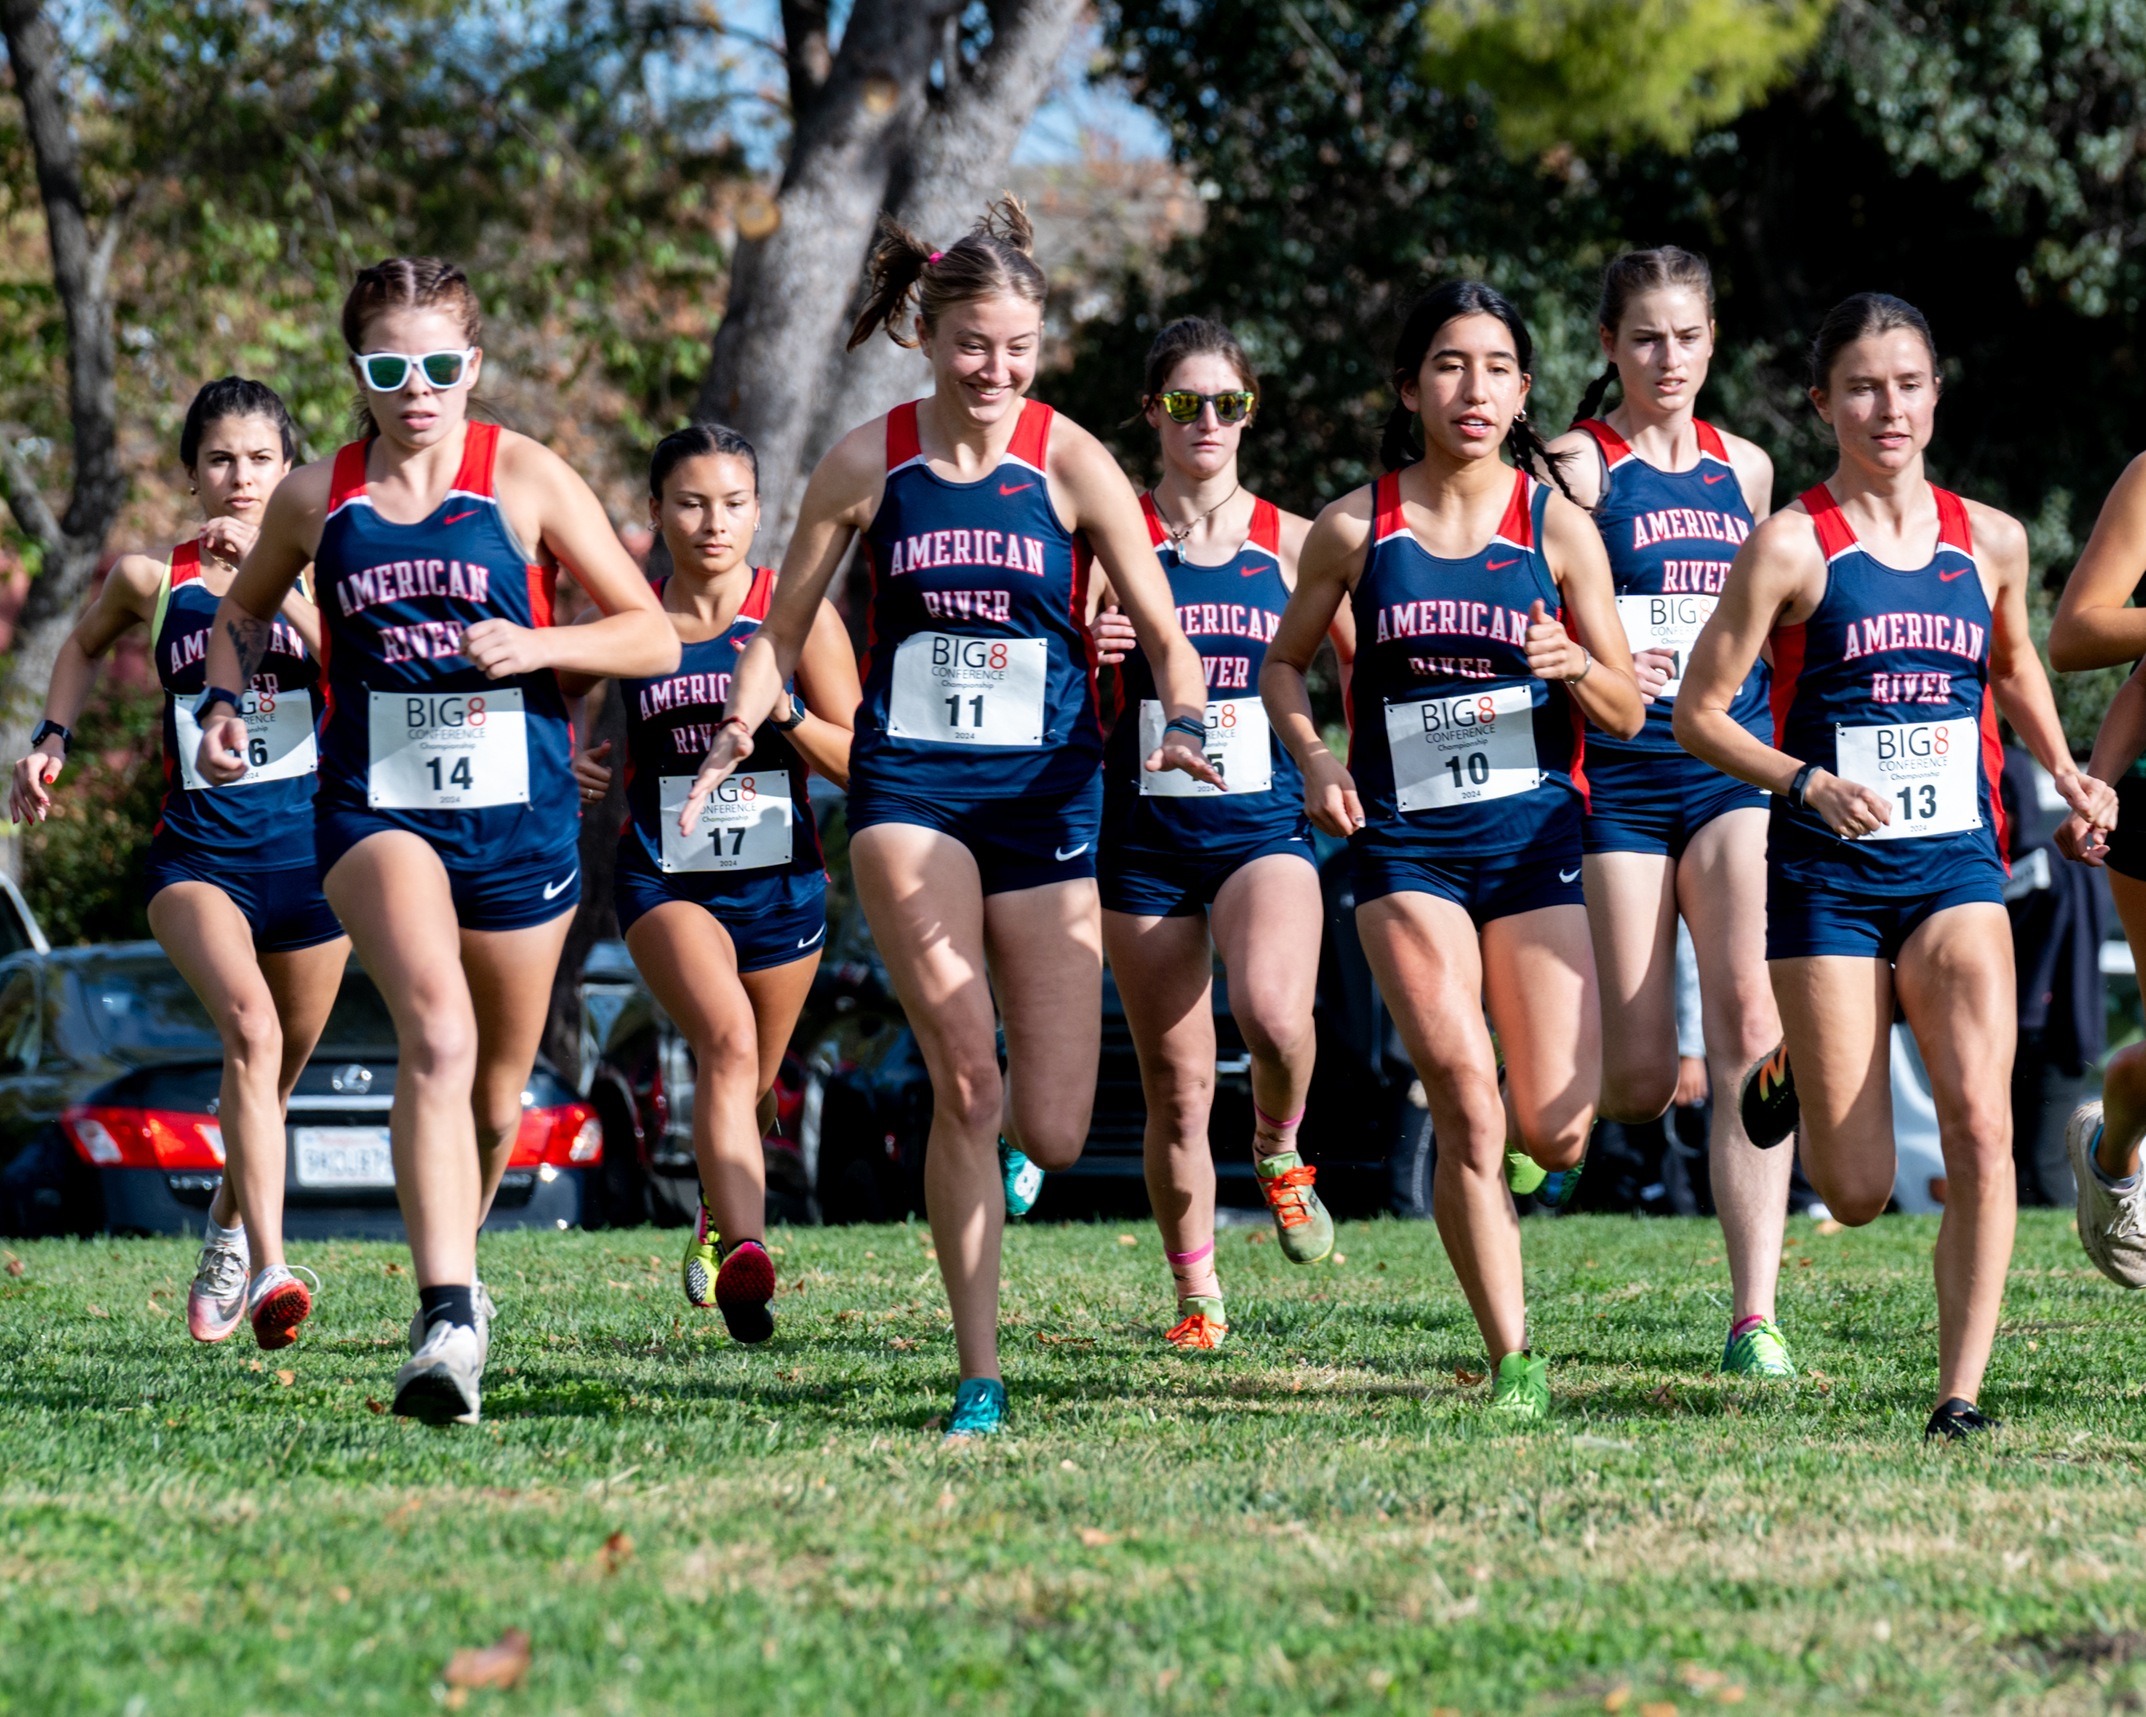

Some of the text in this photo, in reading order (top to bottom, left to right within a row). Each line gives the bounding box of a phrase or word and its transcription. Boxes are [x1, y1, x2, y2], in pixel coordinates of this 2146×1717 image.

[890, 529, 1045, 577] AMERICAN
[336, 560, 489, 617] AMERICAN
[922, 590, 1011, 622] RIVER
[1175, 604, 1280, 644] ERICAN
[1376, 600, 1529, 648] AMERICAN
[1843, 612, 1984, 662] AMERICAN
[171, 622, 304, 675] AMAN
[932, 636, 1007, 670] BIG8
[931, 666, 1005, 681] CONFERENCE
[941, 680, 994, 690] Championship
[1201, 656, 1250, 689] VER
[1872, 672, 1951, 704] RIVER
[406, 697, 486, 728] BIG8
[640, 673, 732, 721] AMERIC
[945, 694, 984, 728] 11
[1421, 696, 1496, 733] BIG8
[408, 728, 486, 740] CONFERENCE
[420, 741, 476, 751] Championship
[955, 732, 975, 740] 2024
[1426, 724, 1496, 744] CONFERENCE
[1438, 737, 1488, 752] Championship
[1877, 726, 1949, 760] BIG8
[426, 756, 473, 790] 14
[1445, 752, 1489, 788] 10
[1878, 756, 1948, 772] CONFERENCE
[1891, 771, 1940, 781] Championship
[700, 802, 756, 815] ONFERENCE
[1462, 790, 1481, 799] 2024
[1897, 784, 1937, 820] 13
[702, 814, 749, 824] Championship
[708, 827, 746, 857] 17
